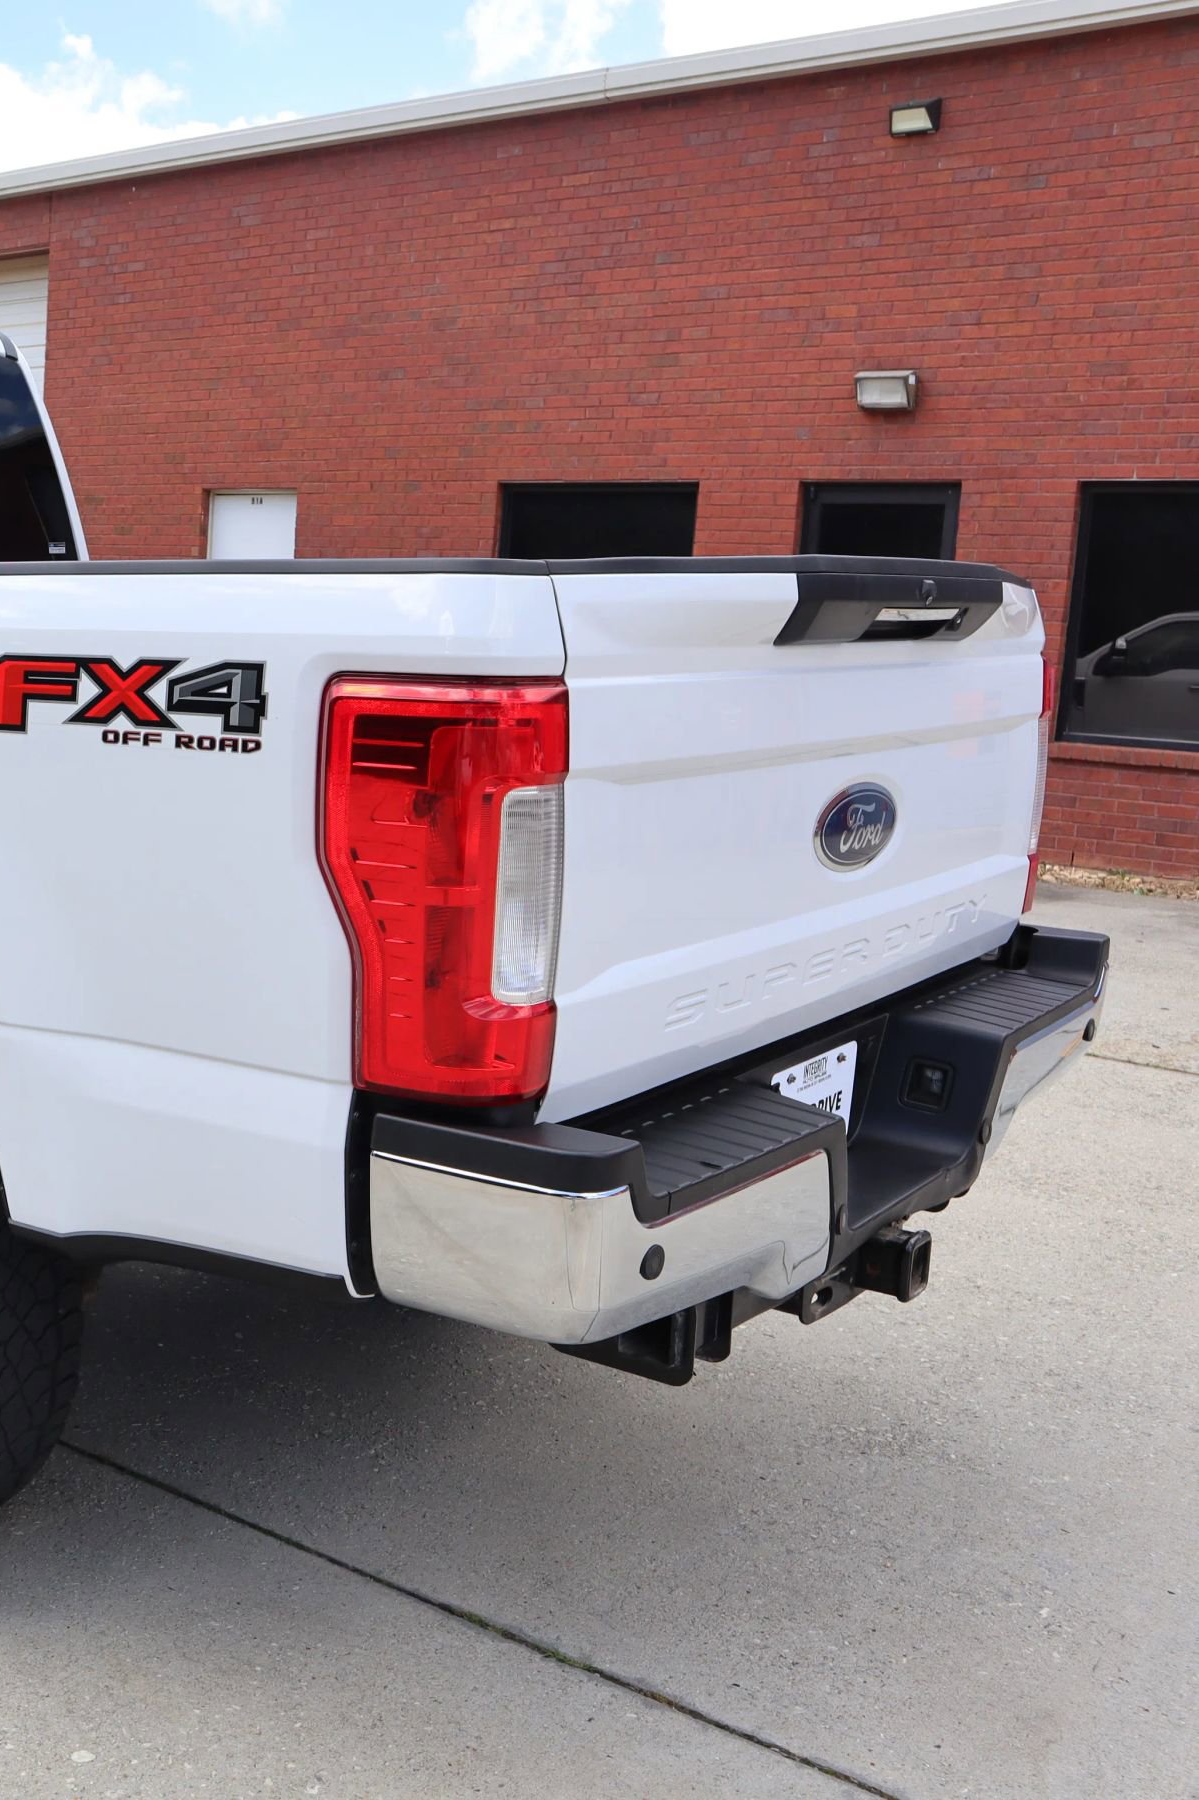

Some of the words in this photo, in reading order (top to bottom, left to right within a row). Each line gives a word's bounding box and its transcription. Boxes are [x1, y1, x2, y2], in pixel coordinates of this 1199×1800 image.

[101, 729, 162, 747] OFF
[175, 733, 262, 754] ROAD
[840, 802, 886, 853] Ford
[664, 937, 871, 1032] SUPER
[881, 894, 988, 959] DUTY
[804, 1056, 828, 1079] INTEGRITY
[811, 1090, 842, 1113] RIVE
